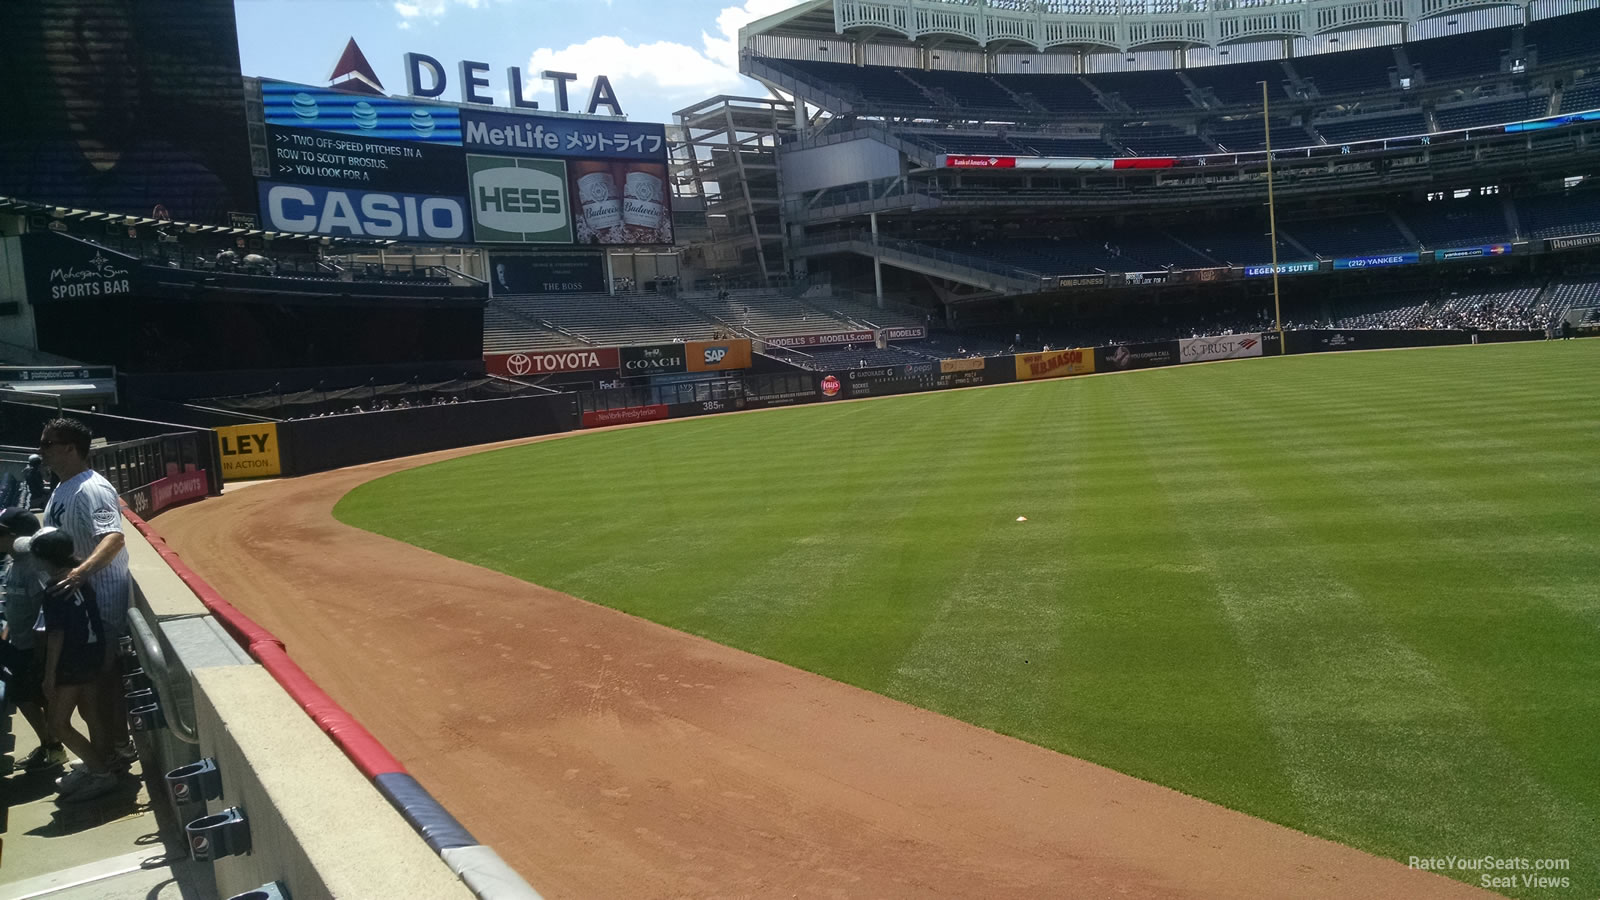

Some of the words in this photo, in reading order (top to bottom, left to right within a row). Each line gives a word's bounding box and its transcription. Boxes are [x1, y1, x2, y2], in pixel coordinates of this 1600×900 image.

[403, 52, 624, 115] DELTA
[466, 120, 560, 149] MetLife
[291, 134, 314, 146] TWO
[316, 137, 363, 152] OFF-SPEED
[365, 145, 401, 156] PITCHES
[403, 148, 413, 157] IN
[415, 149, 422, 158] A
[566, 131, 661, 153] メットライフ
[277, 148, 299, 160] ROW
[301, 151, 314, 161] TO
[316, 153, 345, 164] SCOTT
[348, 157, 388, 169] BROSIUS.
[295, 165, 315, 176] YOU
[317, 166, 341, 178] LOOK
[343, 170, 361, 180] FOR
[362, 171, 370, 181] A
[479, 186, 561, 213] HESS
[268, 186, 464, 239] CASIO
[1444, 249, 1482, 259] yankees.com
[1288, 264, 1313, 273] SUITE
[1348, 258, 1366, 268] (212)
[1367, 256, 1403, 266] YANKEES
[103, 265, 129, 278] Sun
[52, 282, 100, 299] SPORTS
[103, 279, 129, 295] BAR
[543, 282, 560, 291] THE
[561, 282, 583, 291] BOSS
[819, 332, 872, 344] MODELLS.com
[704, 349, 725, 362] SAP
[1183, 345, 1198, 357] U.S.
[1200, 342, 1236, 354] TRUST
[533, 352, 600, 371] TOYOTA
[626, 357, 681, 369] COACH
[913, 364, 932, 374] pepsi
[600, 379, 626, 390] FedEx
[223, 461, 233, 470] IN
